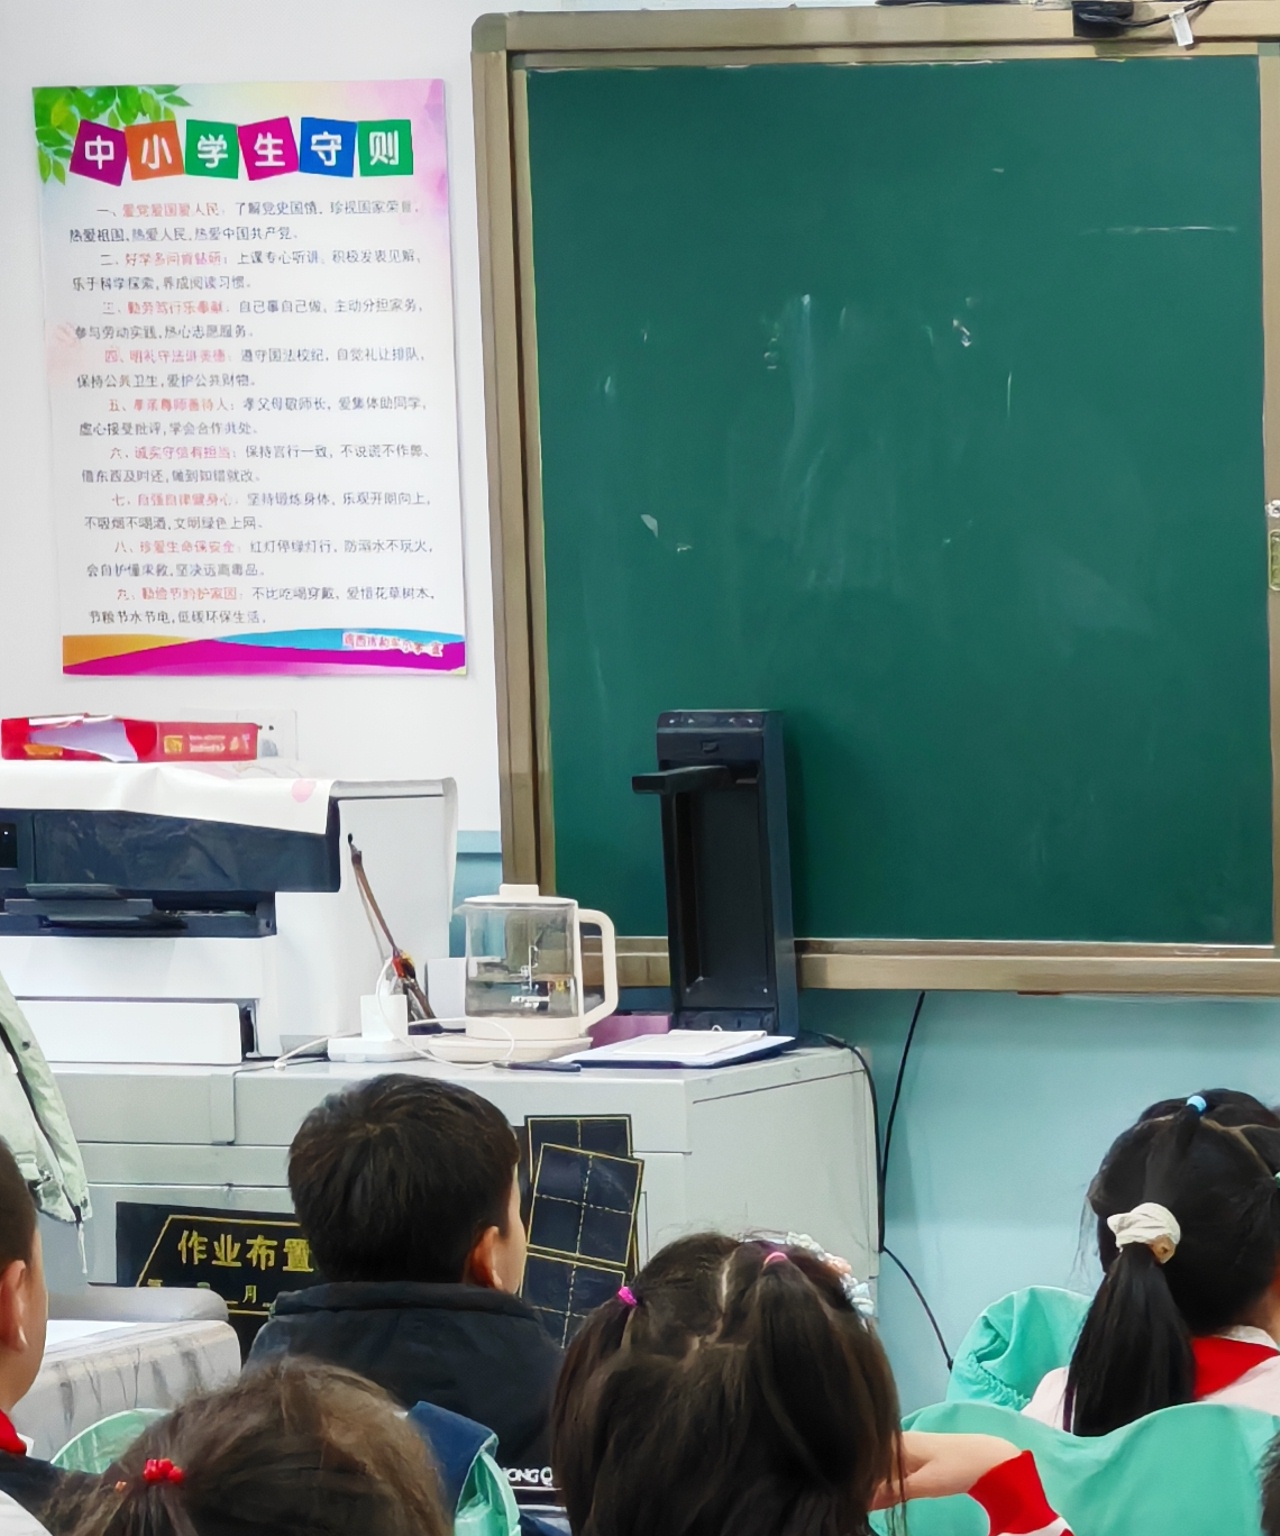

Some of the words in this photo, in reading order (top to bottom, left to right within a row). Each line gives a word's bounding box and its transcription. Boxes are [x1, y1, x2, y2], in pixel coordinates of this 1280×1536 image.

[84, 130, 400, 170] 中小学生守则
[177, 1229, 314, 1273] 作业布置
[242, 1284, 257, 1303] 月
